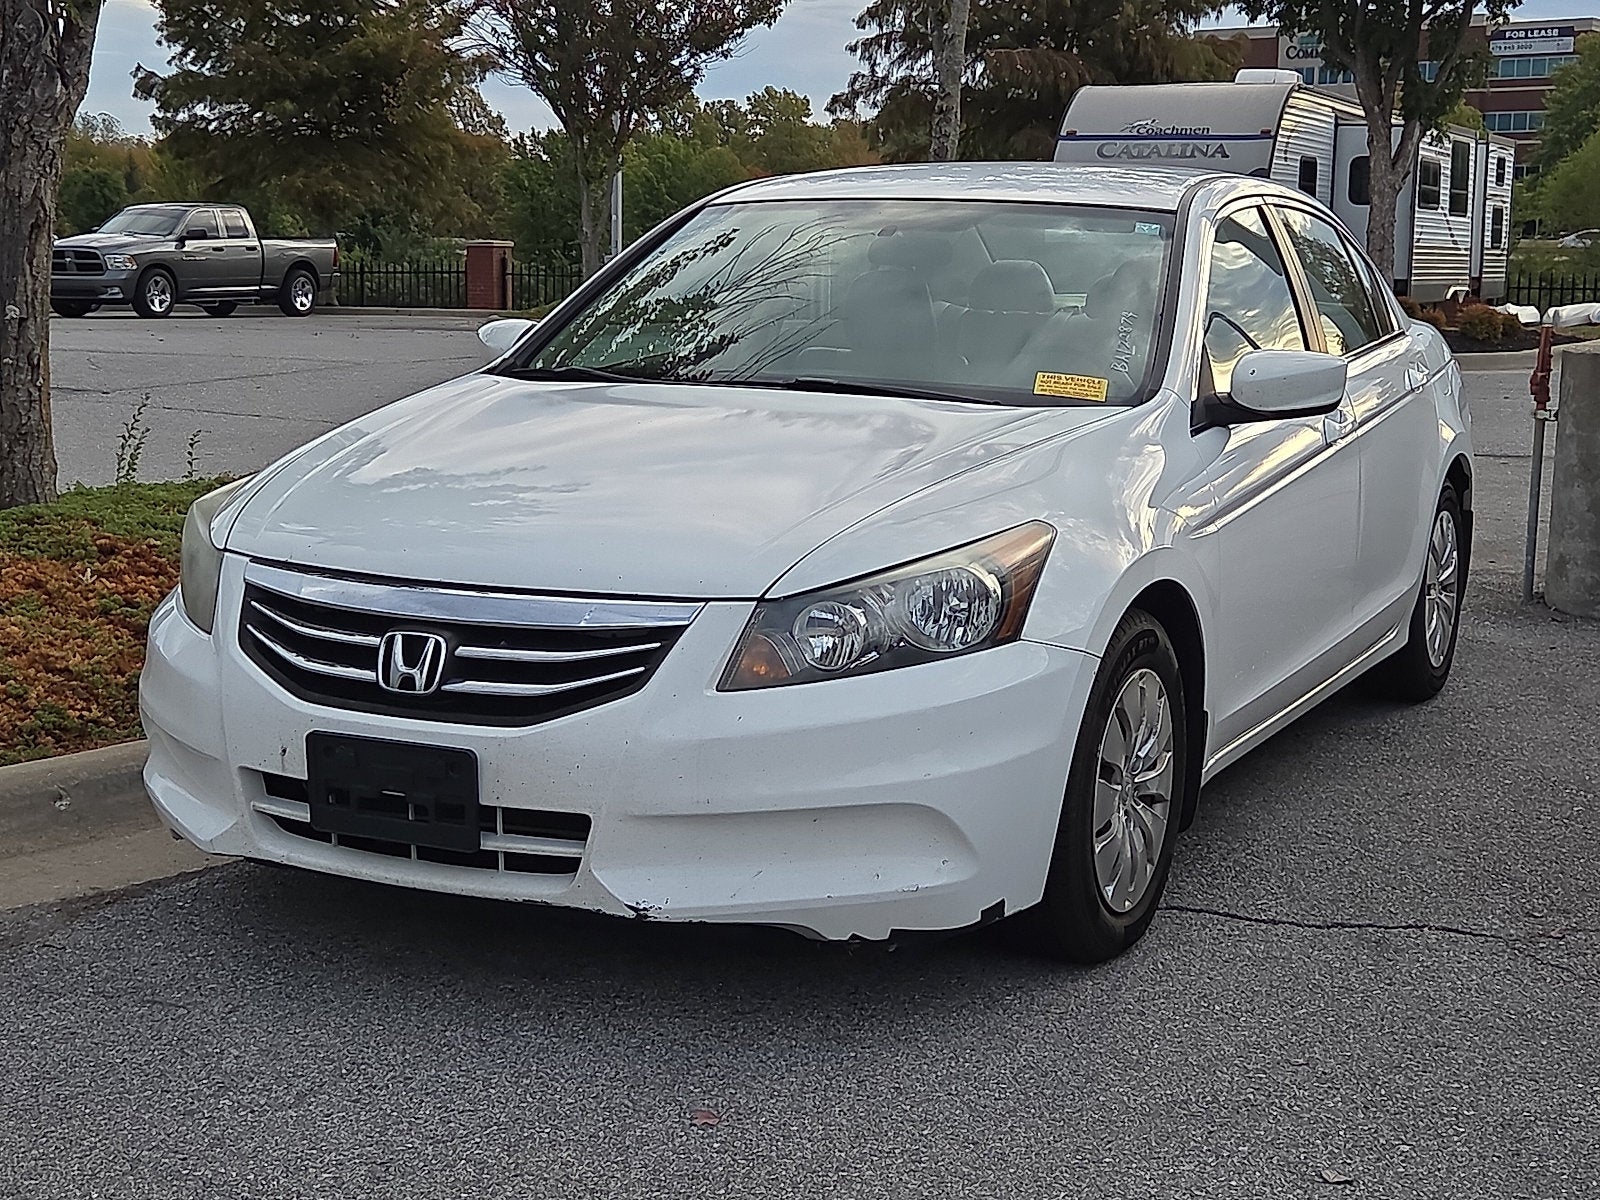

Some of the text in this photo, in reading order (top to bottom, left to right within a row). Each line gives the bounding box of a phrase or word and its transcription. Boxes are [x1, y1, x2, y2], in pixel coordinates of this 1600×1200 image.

[1505, 28, 1559, 38] FOR LEASE
[1136, 125, 1210, 135] Coachmen
[1096, 142, 1230, 159] CATALINA
[1064, 375, 1103, 384] VEHICLE
